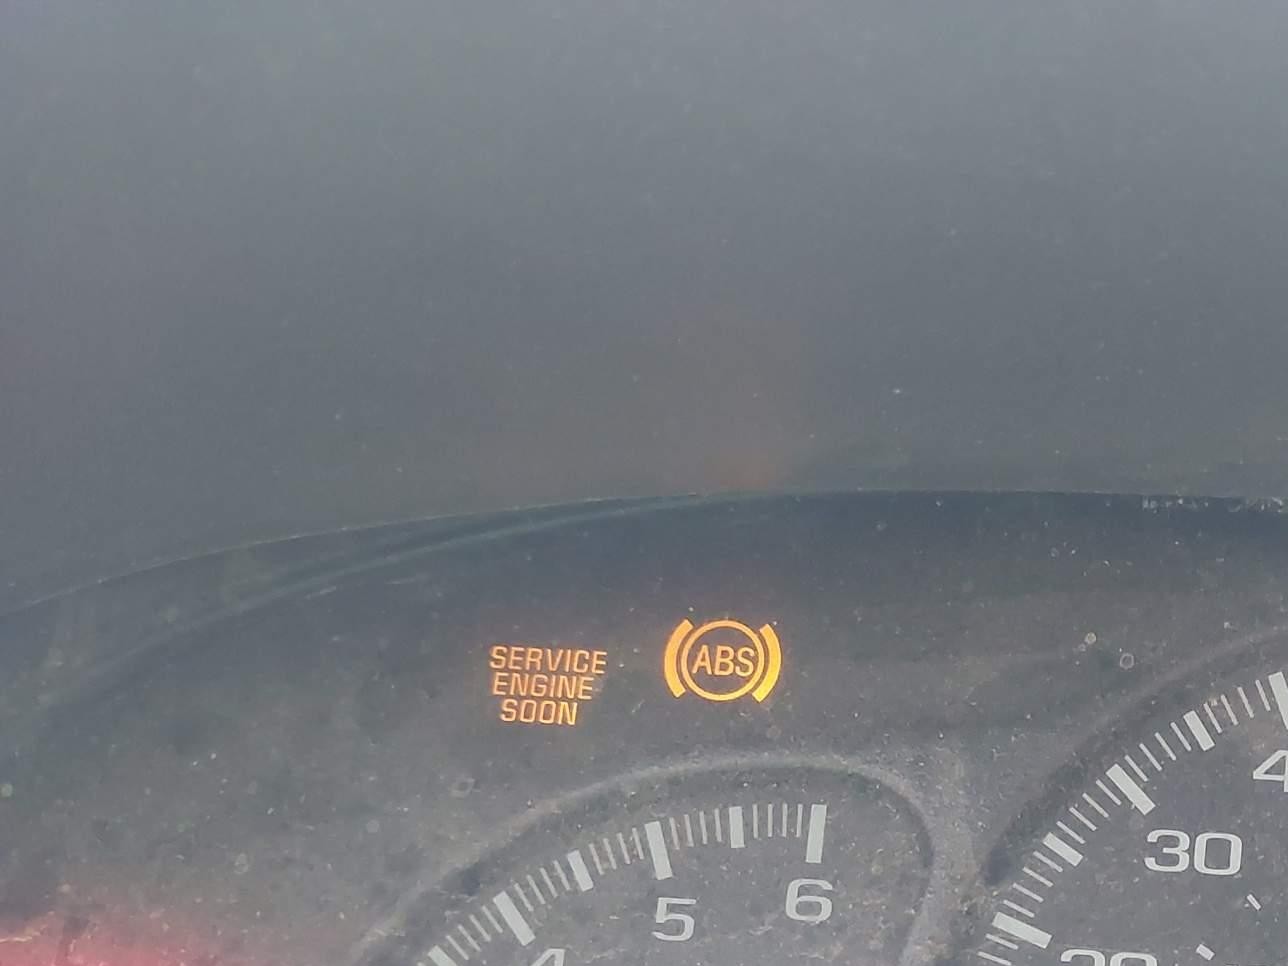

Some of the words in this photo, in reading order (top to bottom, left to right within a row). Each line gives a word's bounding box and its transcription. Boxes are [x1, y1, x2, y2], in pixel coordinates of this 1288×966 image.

[489, 645, 608, 675] SERVICE
[692, 645, 756, 677] ABS
[492, 672, 595, 700] ENGINE
[500, 698, 578, 726] SOON
[1144, 829, 1244, 876] 30
[785, 878, 834, 923] 6
[653, 896, 696, 942] 5
